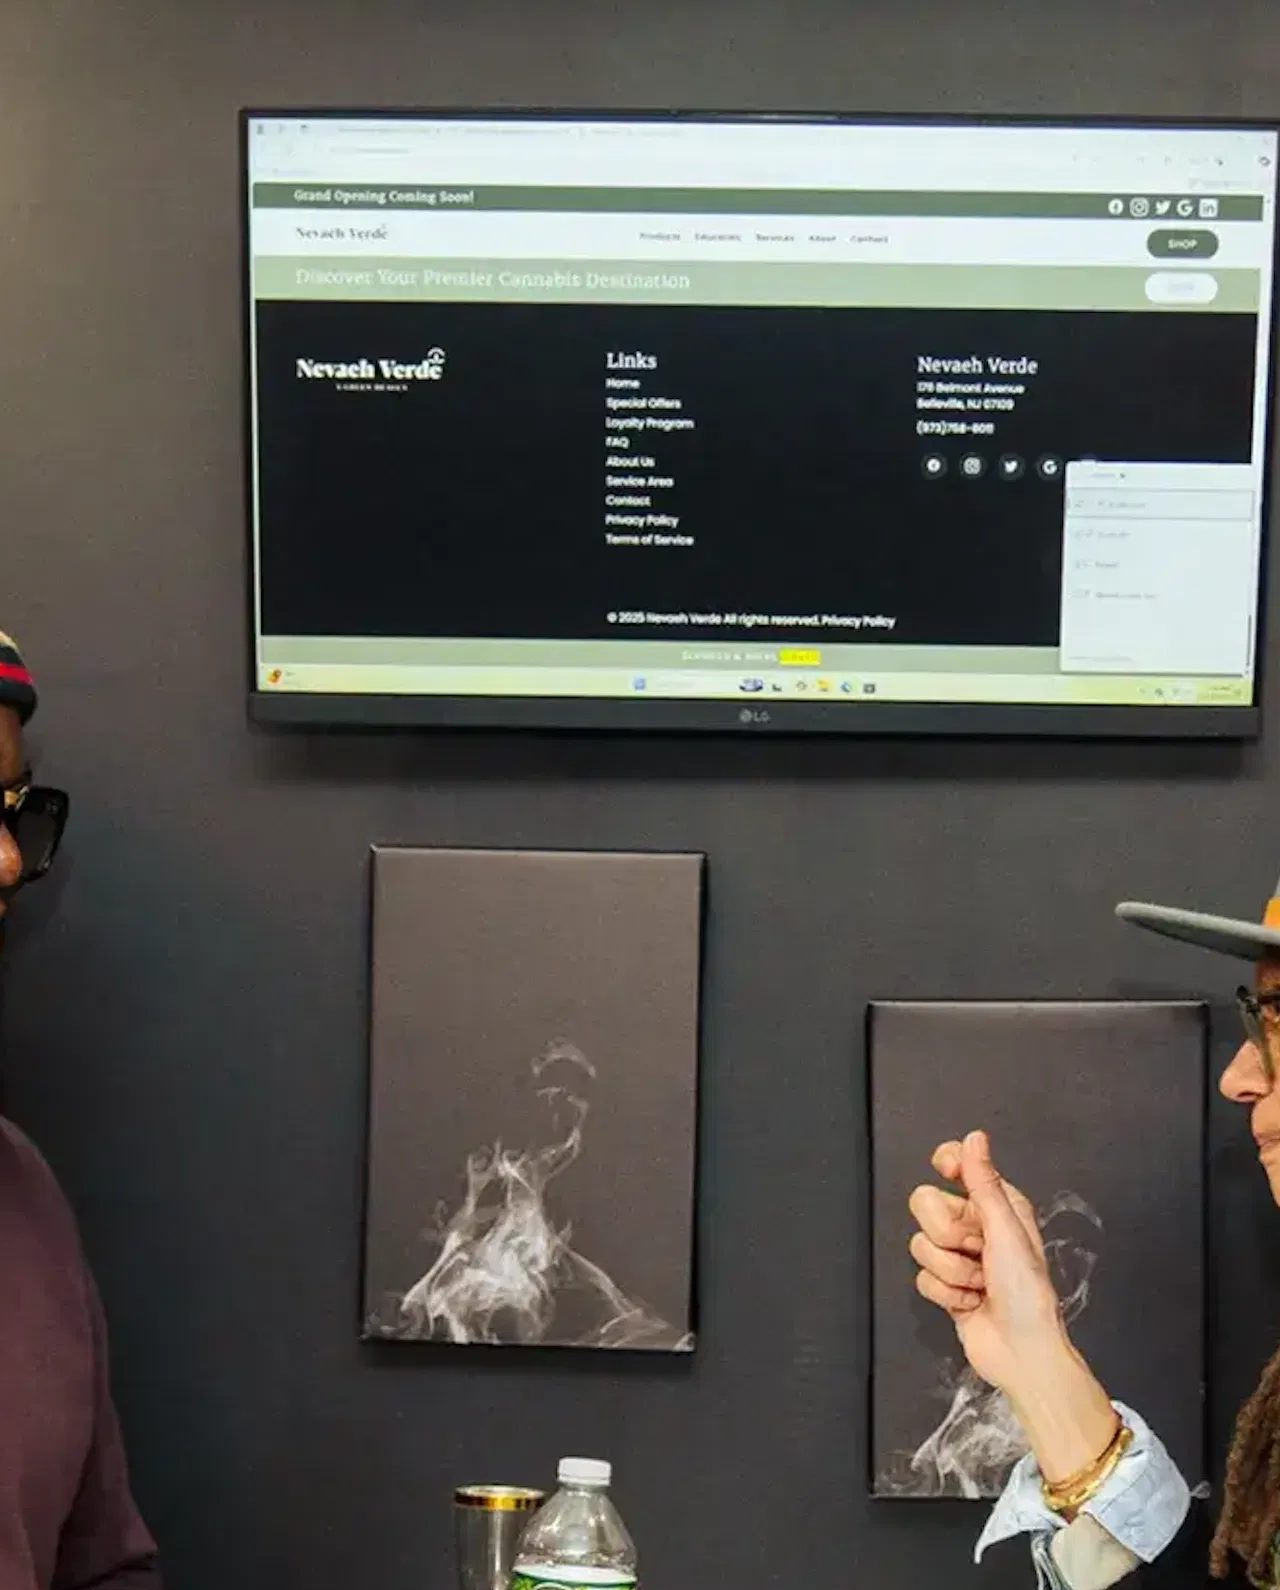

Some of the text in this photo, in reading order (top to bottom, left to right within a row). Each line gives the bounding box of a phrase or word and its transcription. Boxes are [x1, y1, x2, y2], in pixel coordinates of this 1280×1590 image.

[294, 189, 331, 201] Grand
[334, 190, 386, 205] Opening
[389, 191, 437, 205] Coming
[1168, 239, 1198, 250] SHOP
[295, 268, 691, 290] Discover Your Premier Cannabis Destination
[606, 351, 657, 369] Links
[917, 356, 1038, 374] Nevaeh Verde
[295, 358, 444, 380] Nevaeh Verde
[605, 378, 640, 389] Home
[606, 397, 682, 411] Special Offers
[966, 399, 981, 409] NJ
[605, 416, 694, 431] Loyalty Program
[605, 436, 630, 449] FAQ
[605, 455, 656, 467] About Us
[605, 474, 674, 488] Service Area
[605, 494, 651, 507] Contact
[605, 514, 679, 528] Privacy Policy
[605, 533, 694, 546] Terms of Service
[647, 613, 688, 624] Nevaeh
[690, 614, 721, 625] Verde
[738, 615, 769, 627] rights
[822, 615, 861, 628] Privacy
[863, 616, 896, 629] Policy
